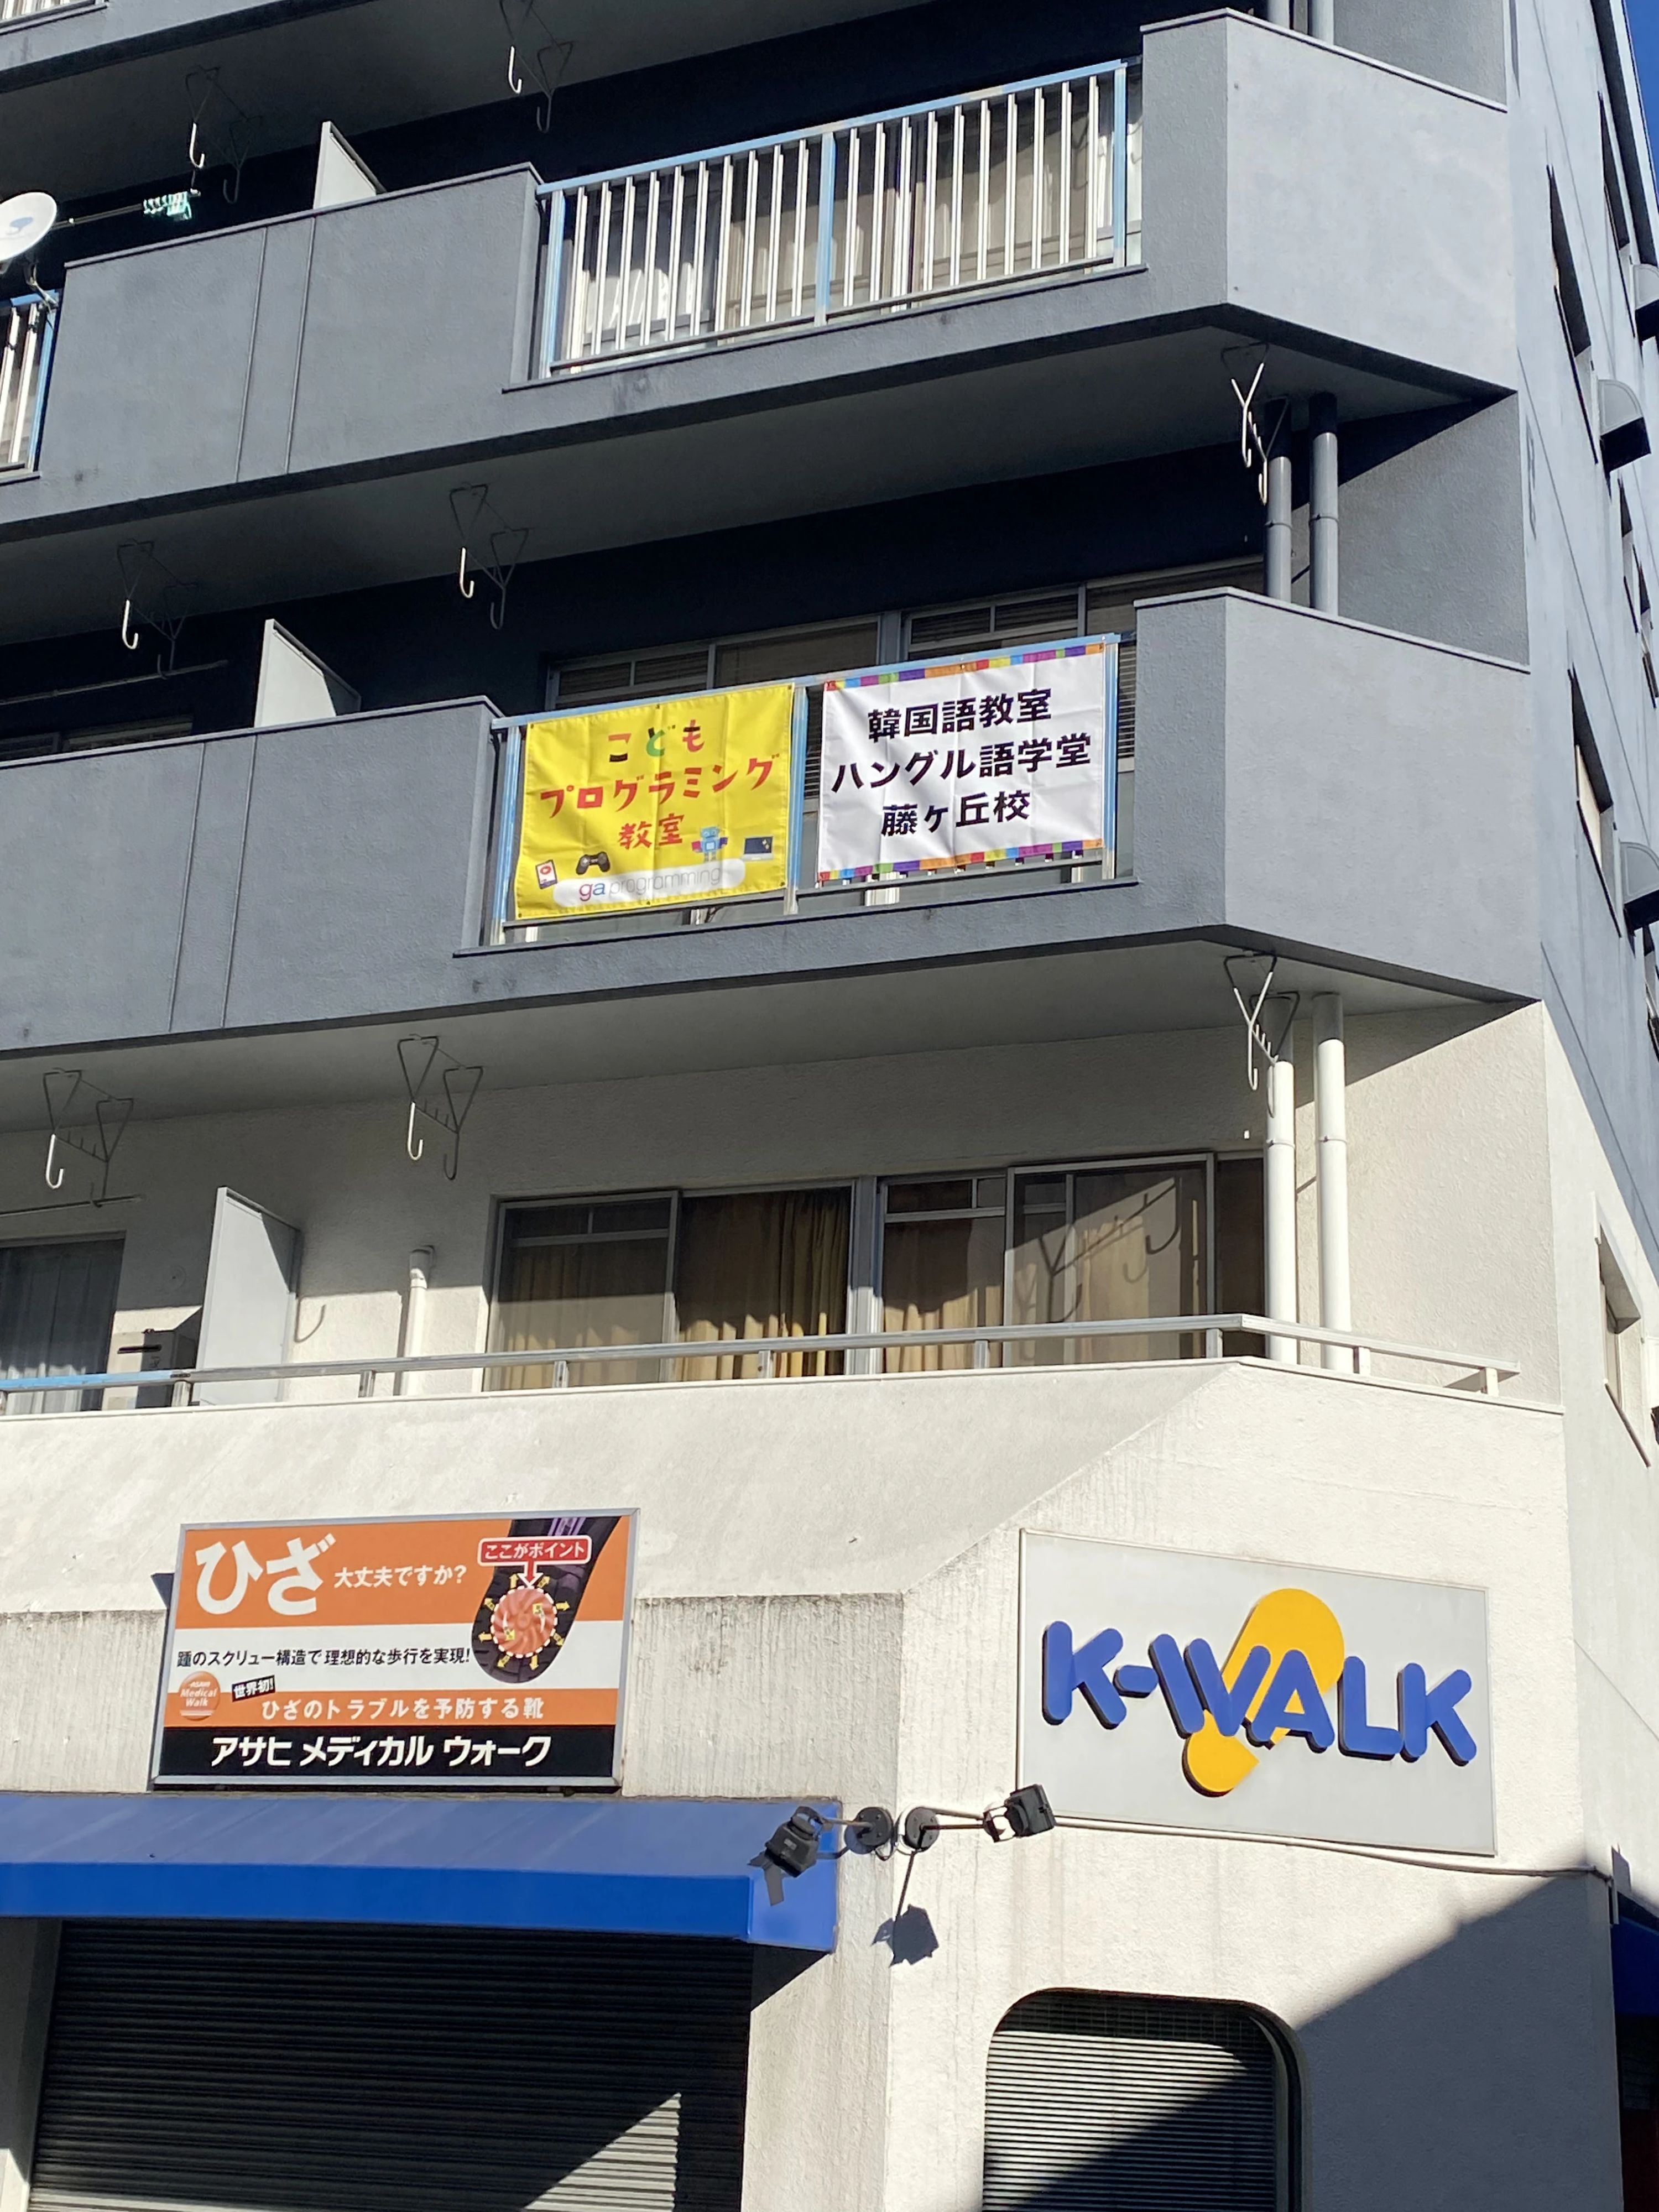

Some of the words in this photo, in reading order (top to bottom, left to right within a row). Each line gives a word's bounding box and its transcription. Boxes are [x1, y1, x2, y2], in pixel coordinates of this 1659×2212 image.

[868, 688, 1052, 743] 韓国語教室
[608, 719, 705, 763] こども
[831, 732, 1092, 793] ハングル語学堂
[540, 753, 780, 819] プログラミング
[618, 813, 685, 850] 教室
[608, 866, 721, 896] programming
[484, 1541, 585, 1560] ここがポイント
[195, 1532, 337, 1616] ひざ
[180, 1687, 218, 1697] Medical
[185, 1697, 208, 1708] Walk
[262, 1697, 545, 1721] ひざのトラブルを予防する靴
[1042, 1620, 1477, 1767] K-WALK
[211, 1736, 293, 1767] アサヒ
[300, 1736, 434, 1767] メディカル
[444, 1736, 551, 1767] ウォーク
